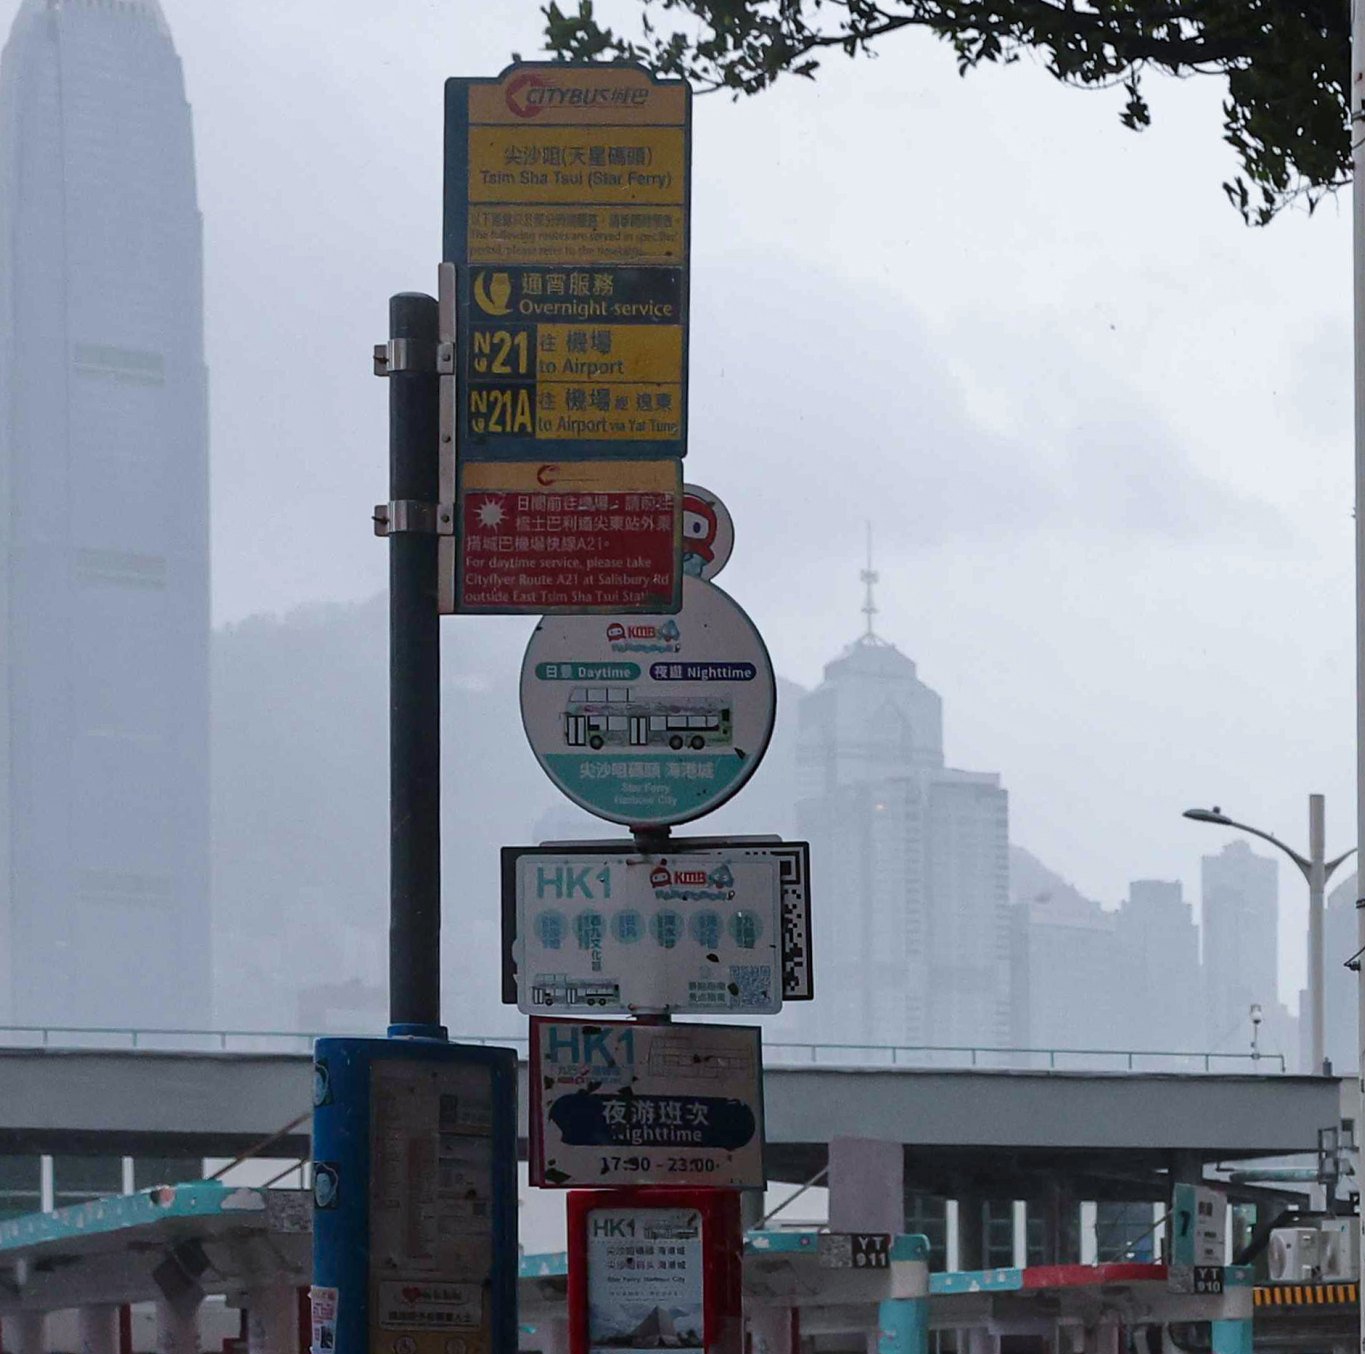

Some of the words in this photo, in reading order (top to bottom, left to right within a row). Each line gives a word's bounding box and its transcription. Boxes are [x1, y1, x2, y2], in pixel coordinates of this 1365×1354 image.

[526, 87, 610, 105] CITYBUS
[480, 170, 516, 185] Tsim
[520, 170, 547, 185] Sha
[554, 170, 583, 185] Tsui
[588, 170, 622, 188] (Star
[628, 170, 672, 189] Ferry)
[522, 272, 614, 296] 通宵服務
[519, 300, 608, 319] Overnight
[613, 301, 672, 316] service
[538, 359, 557, 374] to
[563, 359, 624, 377] Airport
[538, 417, 553, 431] to
[557, 416, 607, 436] Airport
[465, 557, 484, 568] For
[489, 556, 535, 571] daytime
[539, 558, 583, 570] service,
[586, 557, 623, 571] please
[627, 556, 651, 568] take
[519, 574, 552, 586] Route
[556, 574, 579, 586] A21
[583, 575, 594, 586] at
[599, 573, 650, 589] Salisbury
[653, 573, 669, 586] Rd
[465, 591, 511, 602] outside
[513, 591, 536, 602] East
[541, 591, 568, 602] Tsim
[571, 591, 593, 602] Sha
[596, 591, 619, 602] Tsui
[578, 665, 632, 681] Daytime
[688, 665, 752, 681] Nighttime
[535, 866, 611, 899] HK1
[674, 870, 707, 885] KMB
[548, 1026, 635, 1068] HK1
[593, 1218, 636, 1238] HK1
[855, 1252, 886, 1267] 911
[1197, 1281, 1220, 1292] 910
